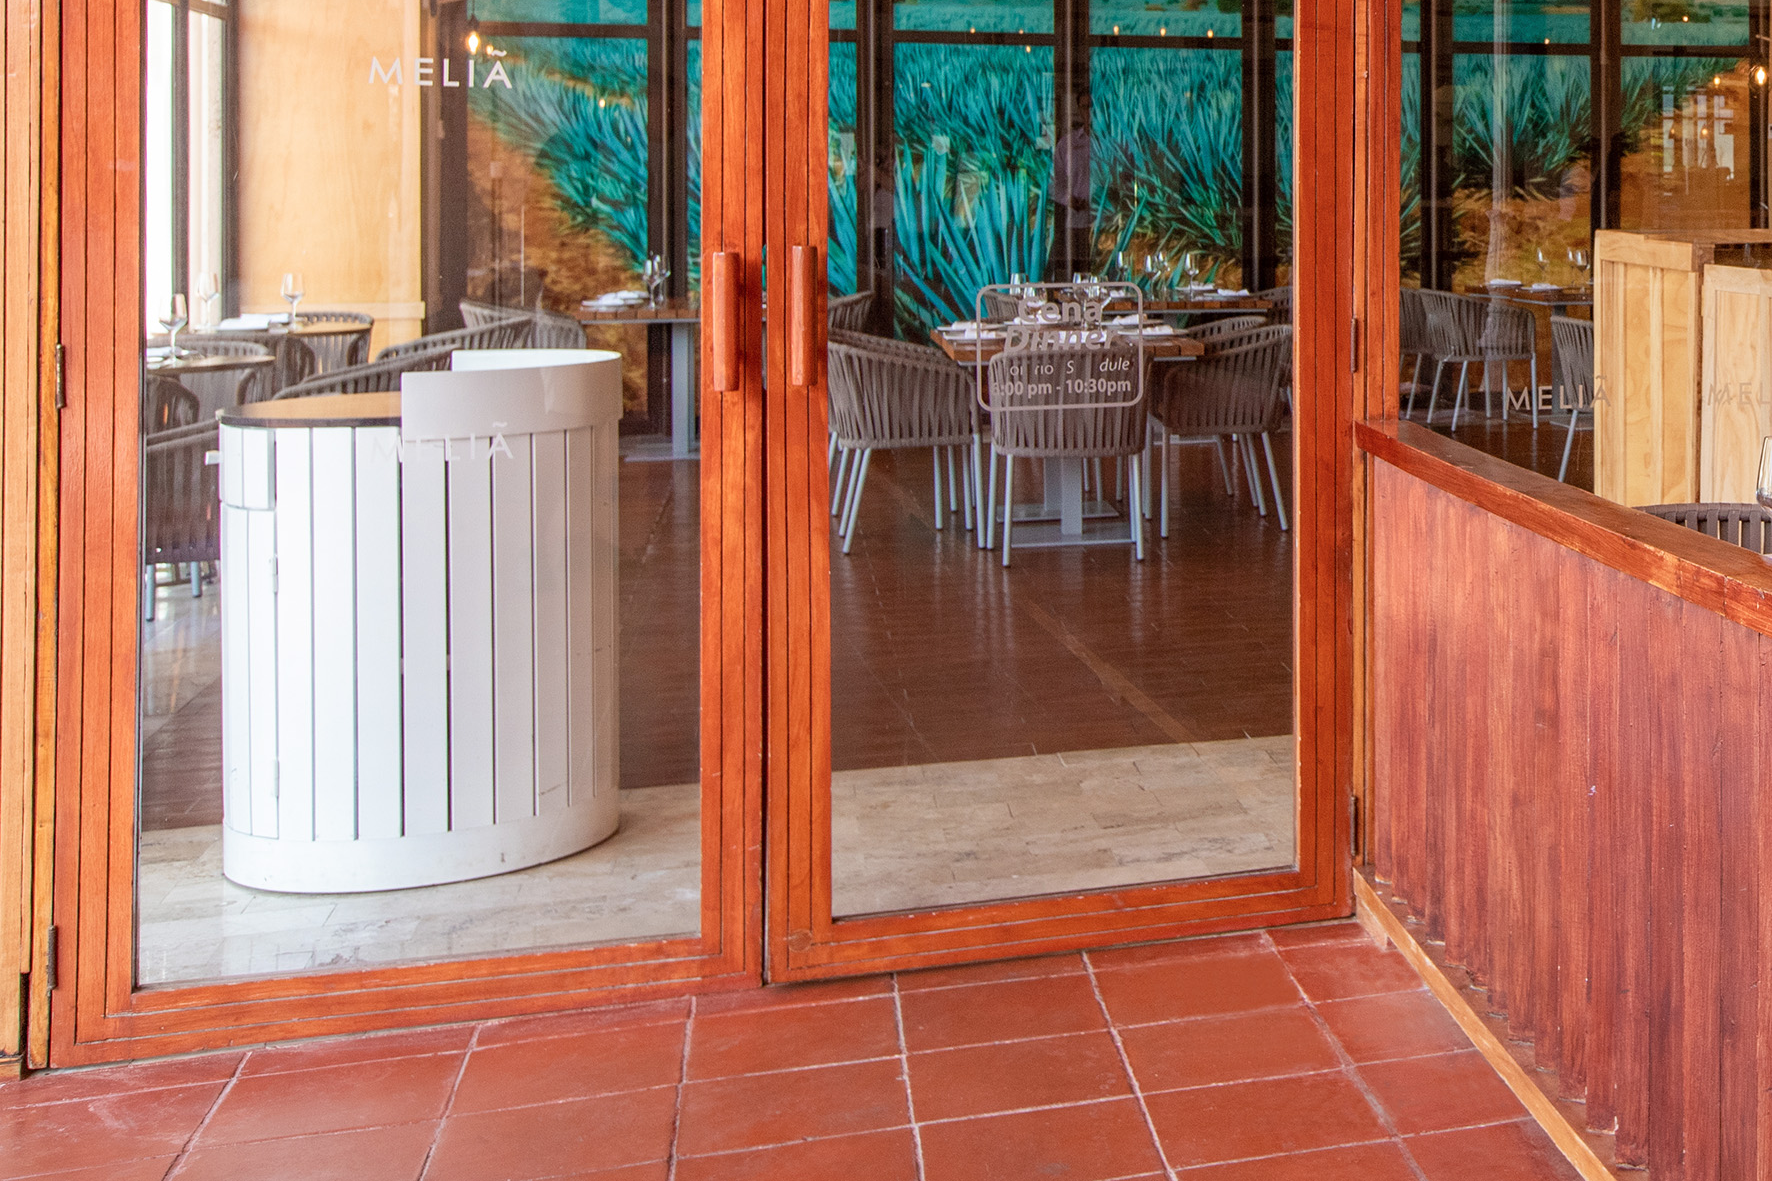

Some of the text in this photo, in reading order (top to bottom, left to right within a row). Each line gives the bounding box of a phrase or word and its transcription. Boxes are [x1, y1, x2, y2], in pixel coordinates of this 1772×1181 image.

[1018, 296, 1102, 323] Cena
[1004, 324, 1119, 353] Dinner
[1066, 357, 1131, 375] Sdule
[1027, 382, 1053, 399] pm
[1065, 378, 1132, 397] 10:30pm
